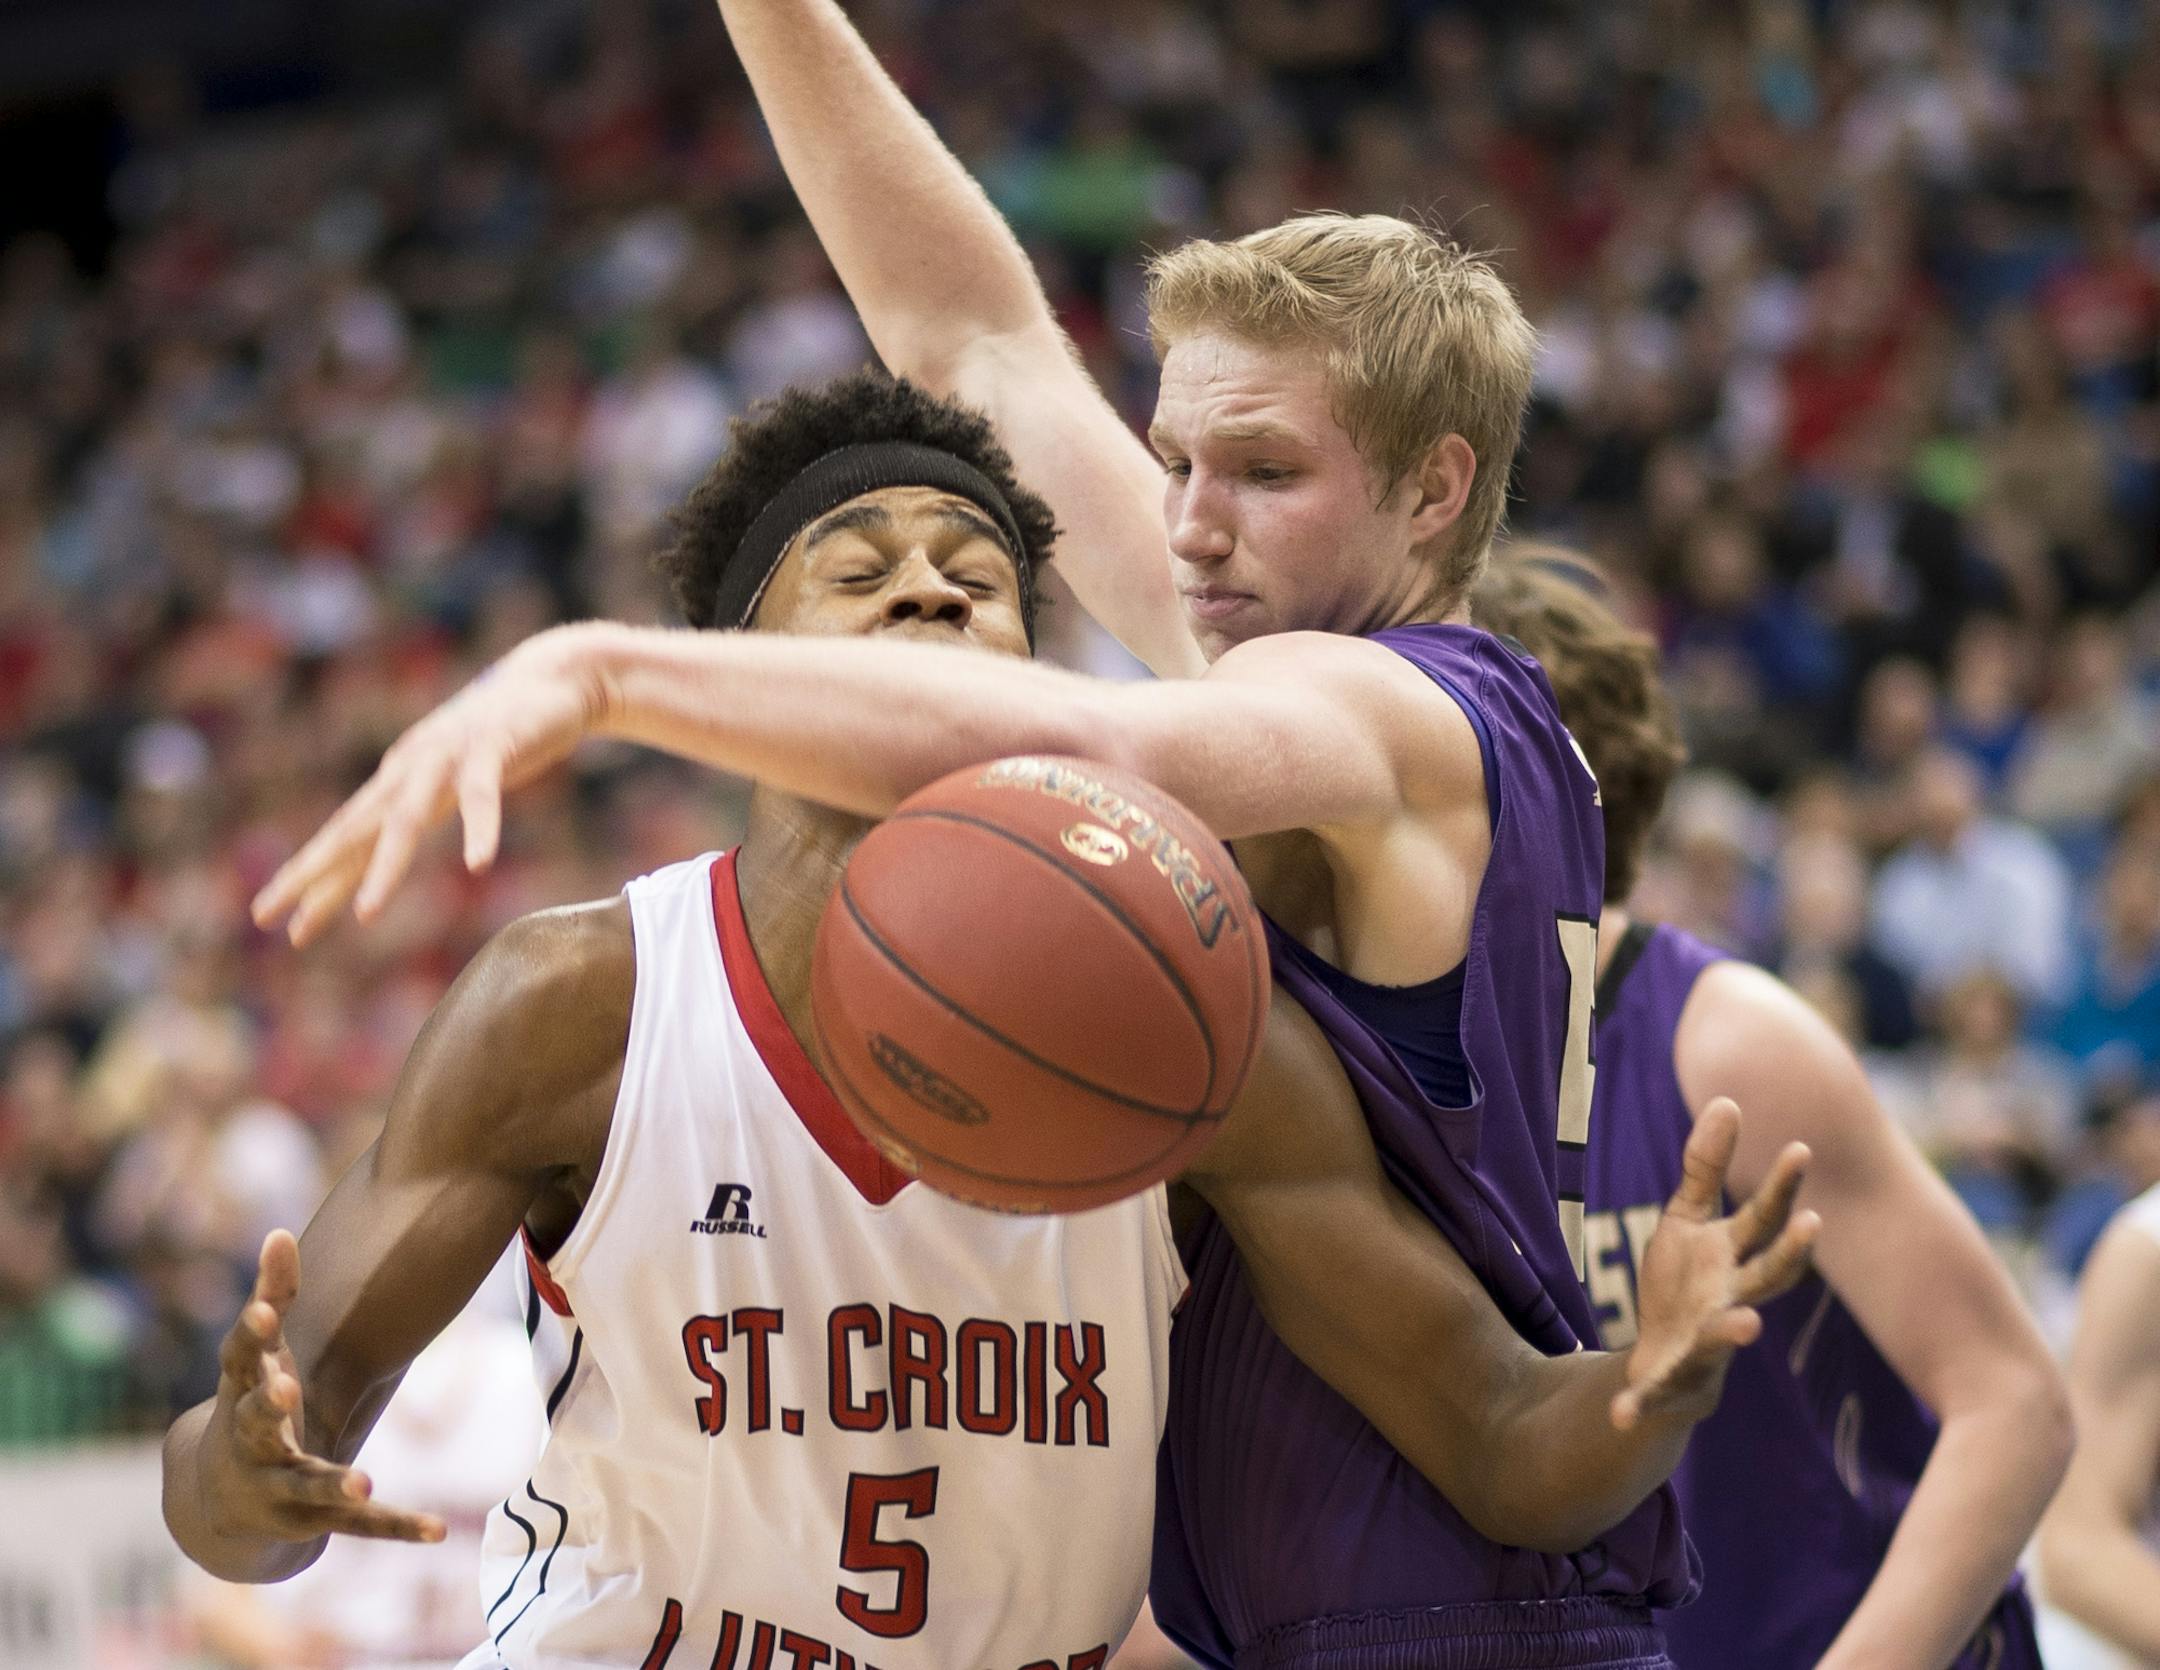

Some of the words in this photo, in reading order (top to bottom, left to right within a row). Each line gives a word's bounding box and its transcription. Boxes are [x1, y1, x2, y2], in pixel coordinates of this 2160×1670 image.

[690, 1220, 767, 1239] RUSSELL
[682, 1307, 804, 1437] ST.
[827, 1302, 1109, 1448] CROIX
[835, 1466, 939, 1640] 5
